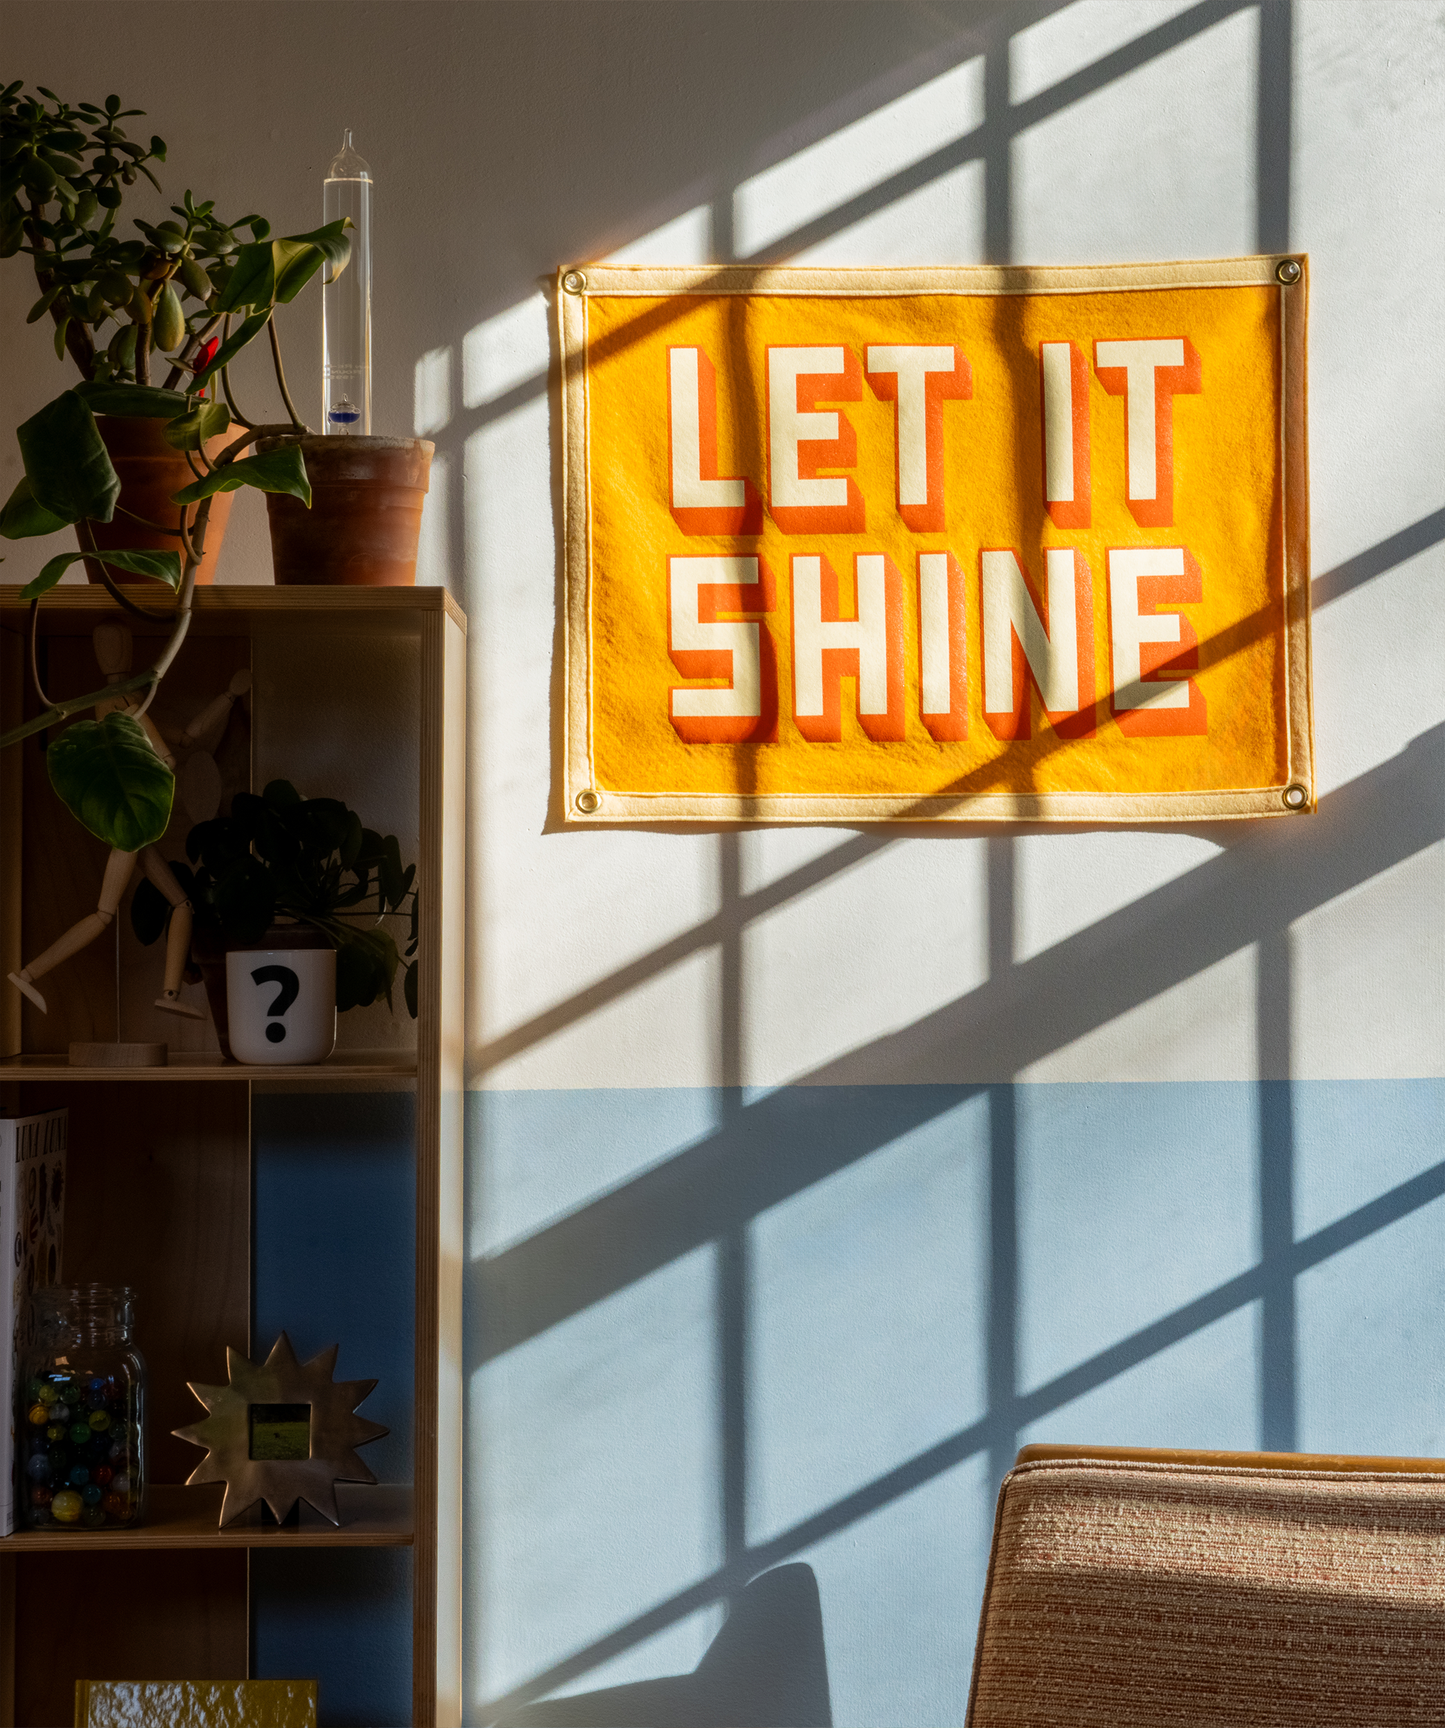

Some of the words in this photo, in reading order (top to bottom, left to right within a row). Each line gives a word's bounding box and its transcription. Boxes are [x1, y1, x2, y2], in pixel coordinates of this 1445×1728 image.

[666, 342, 972, 536] LET
[1039, 335, 1203, 530] IT
[666, 545, 1208, 744] SHINE
[250, 964, 300, 1044] ?
[15, 1122, 40, 1163] LUNA
